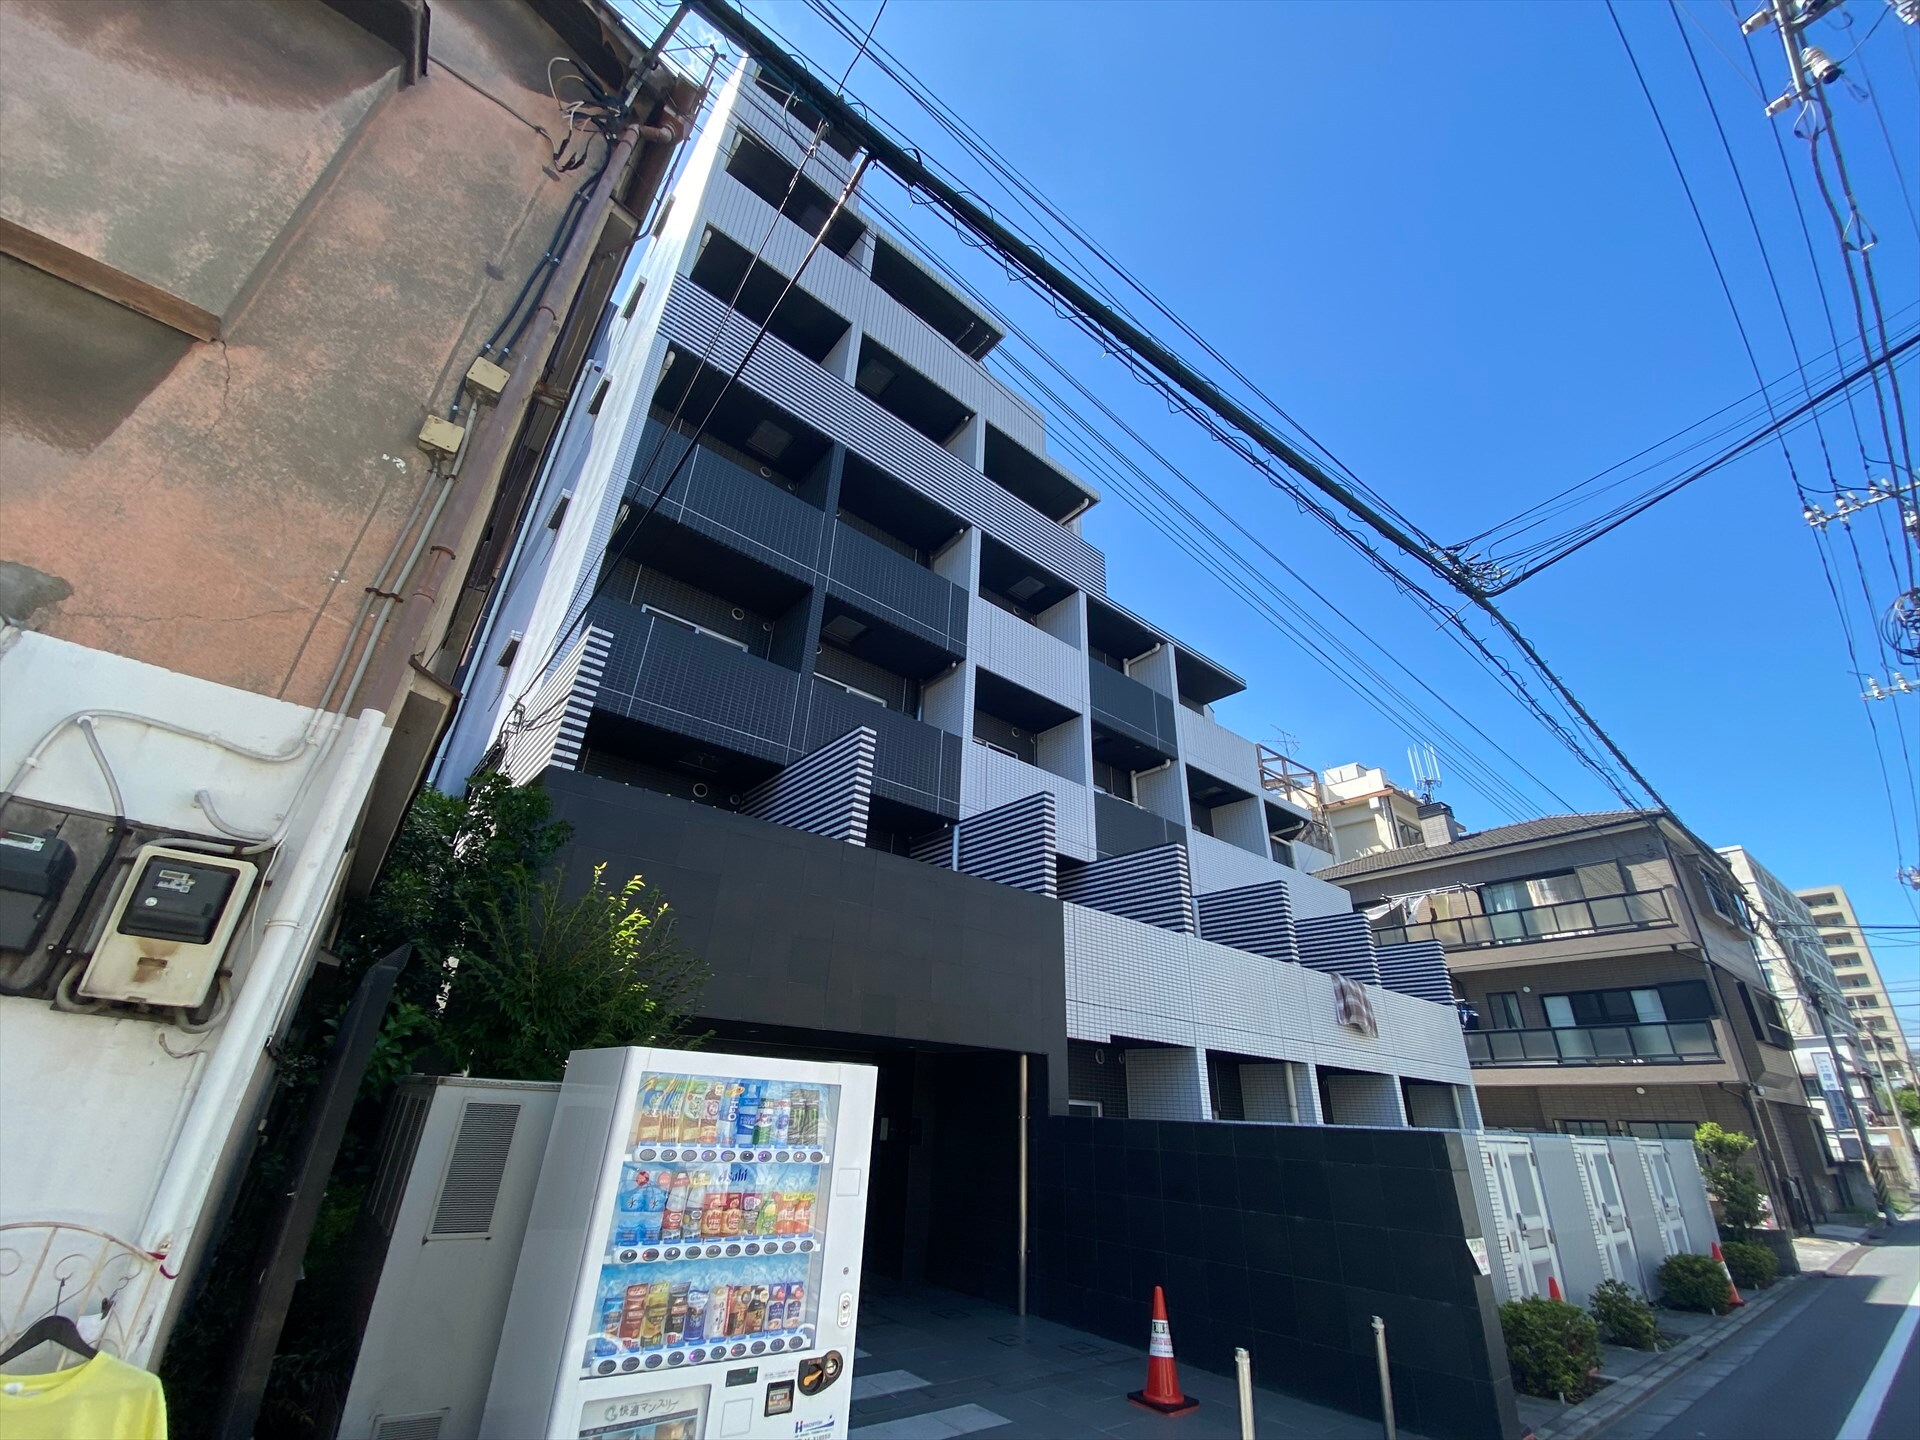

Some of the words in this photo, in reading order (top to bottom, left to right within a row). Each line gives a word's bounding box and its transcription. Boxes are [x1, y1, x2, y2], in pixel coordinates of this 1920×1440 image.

[728, 1101, 739, 1121] H2O
[718, 1168, 748, 1182] Asahi
[620, 1400, 679, 1416] 快適マンスリー
